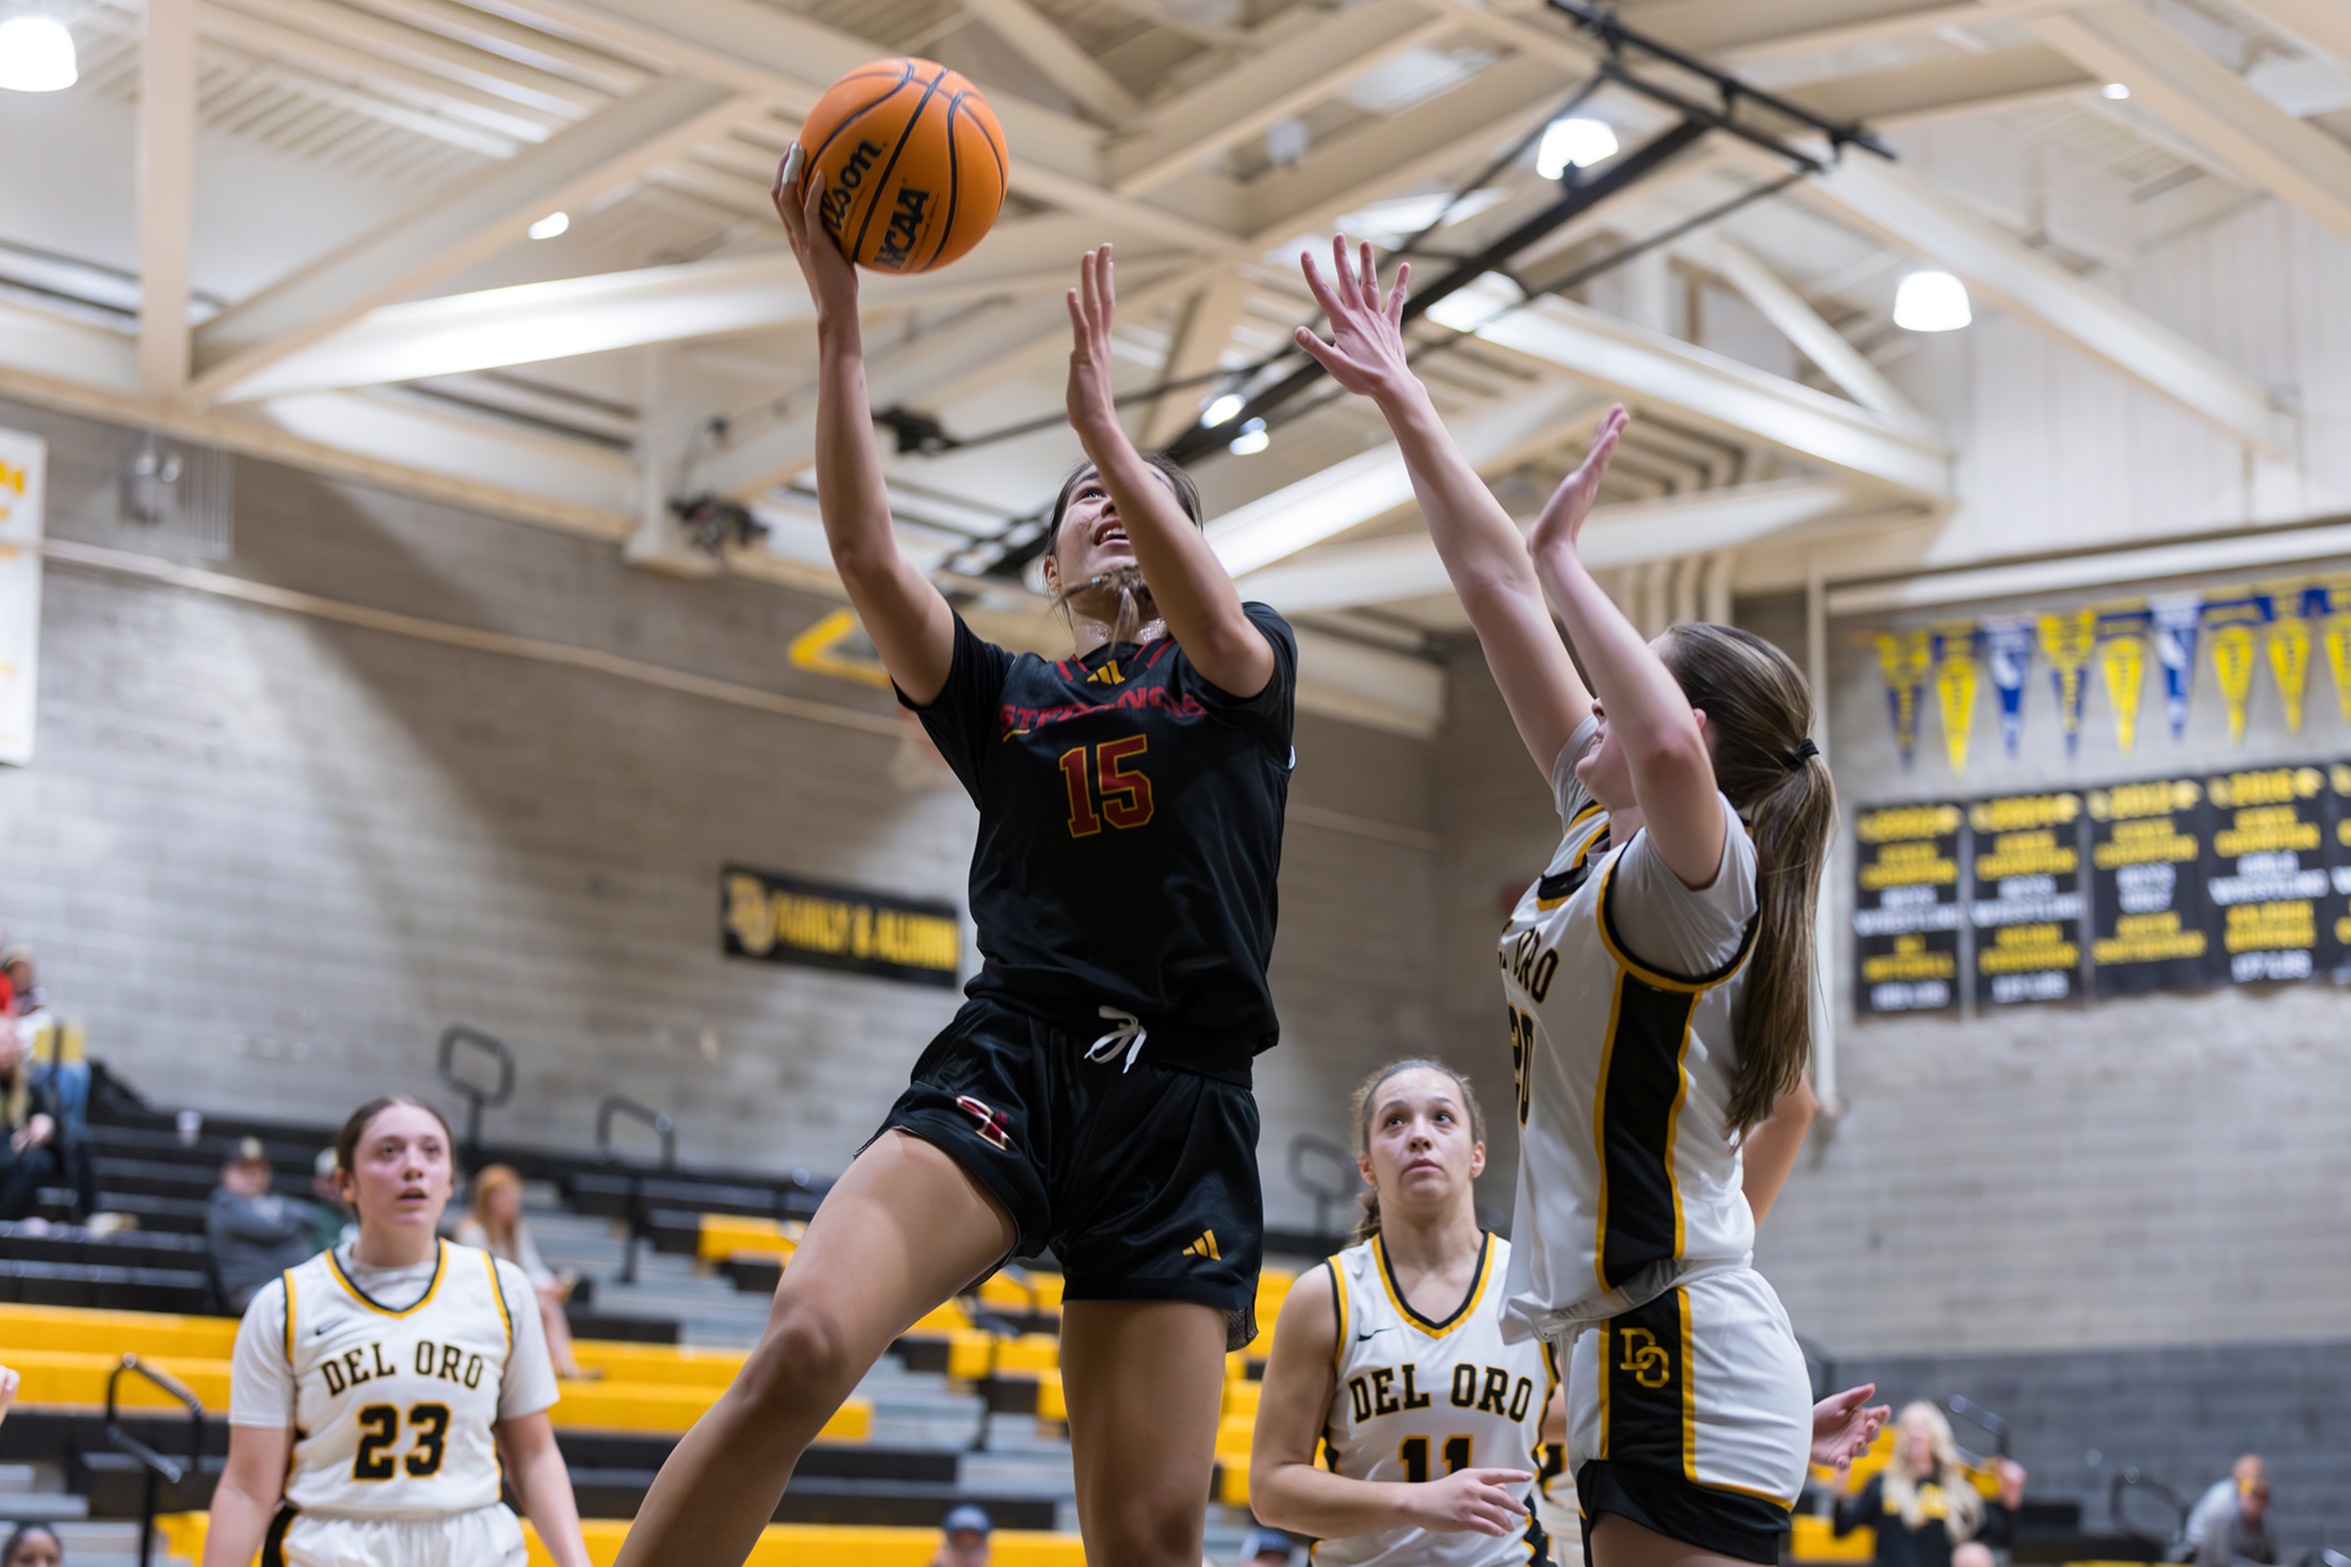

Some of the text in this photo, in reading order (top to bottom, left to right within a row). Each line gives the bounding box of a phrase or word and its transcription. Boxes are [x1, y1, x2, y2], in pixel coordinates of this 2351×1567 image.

[819, 139, 883, 232] ilson
[1059, 733, 1154, 838] 15
[319, 1339, 484, 1398] DEL ORO
[1347, 1361, 1534, 1425] DEL ORO
[352, 1401, 451, 1482] 23
